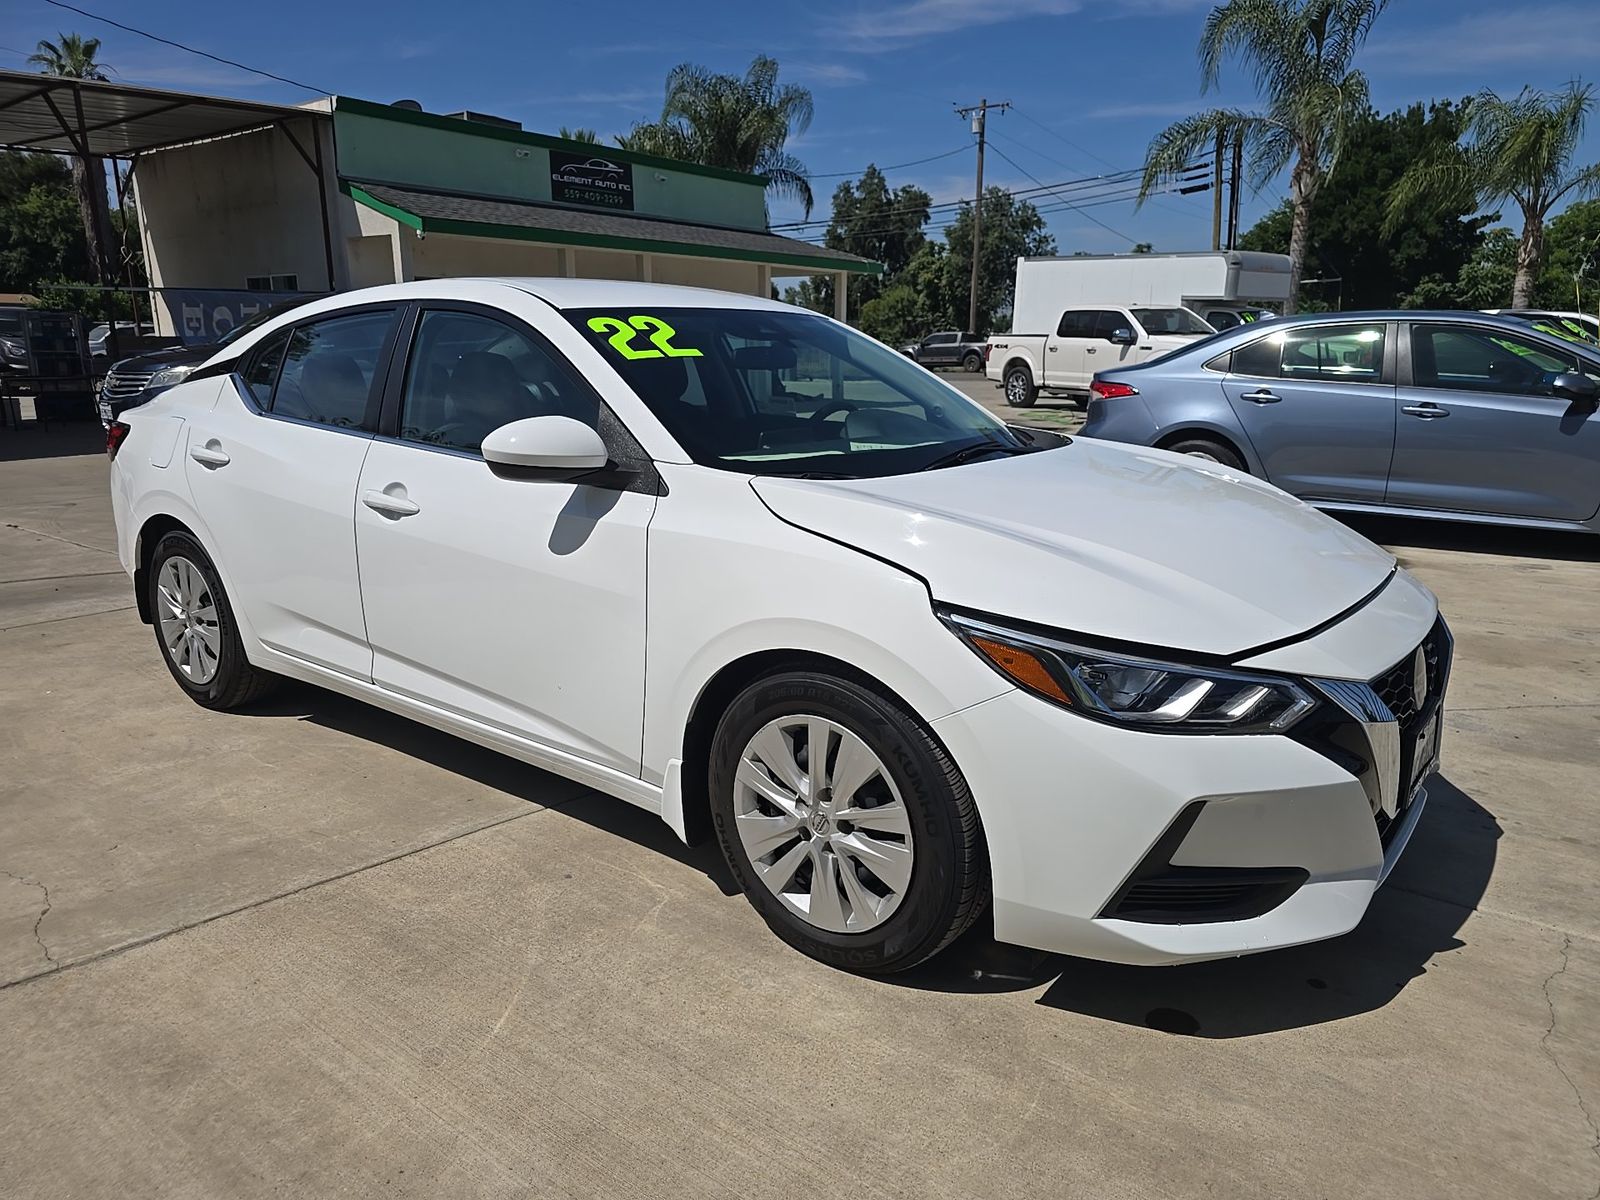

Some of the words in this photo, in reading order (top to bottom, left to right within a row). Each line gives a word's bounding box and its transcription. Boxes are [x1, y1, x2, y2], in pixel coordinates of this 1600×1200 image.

[552, 173, 592, 185] ELEMENT
[595, 180, 617, 189] AUTO
[587, 315, 704, 360] 22
[892, 745, 936, 836] KUMHO
[715, 812, 751, 891] KUMHO
